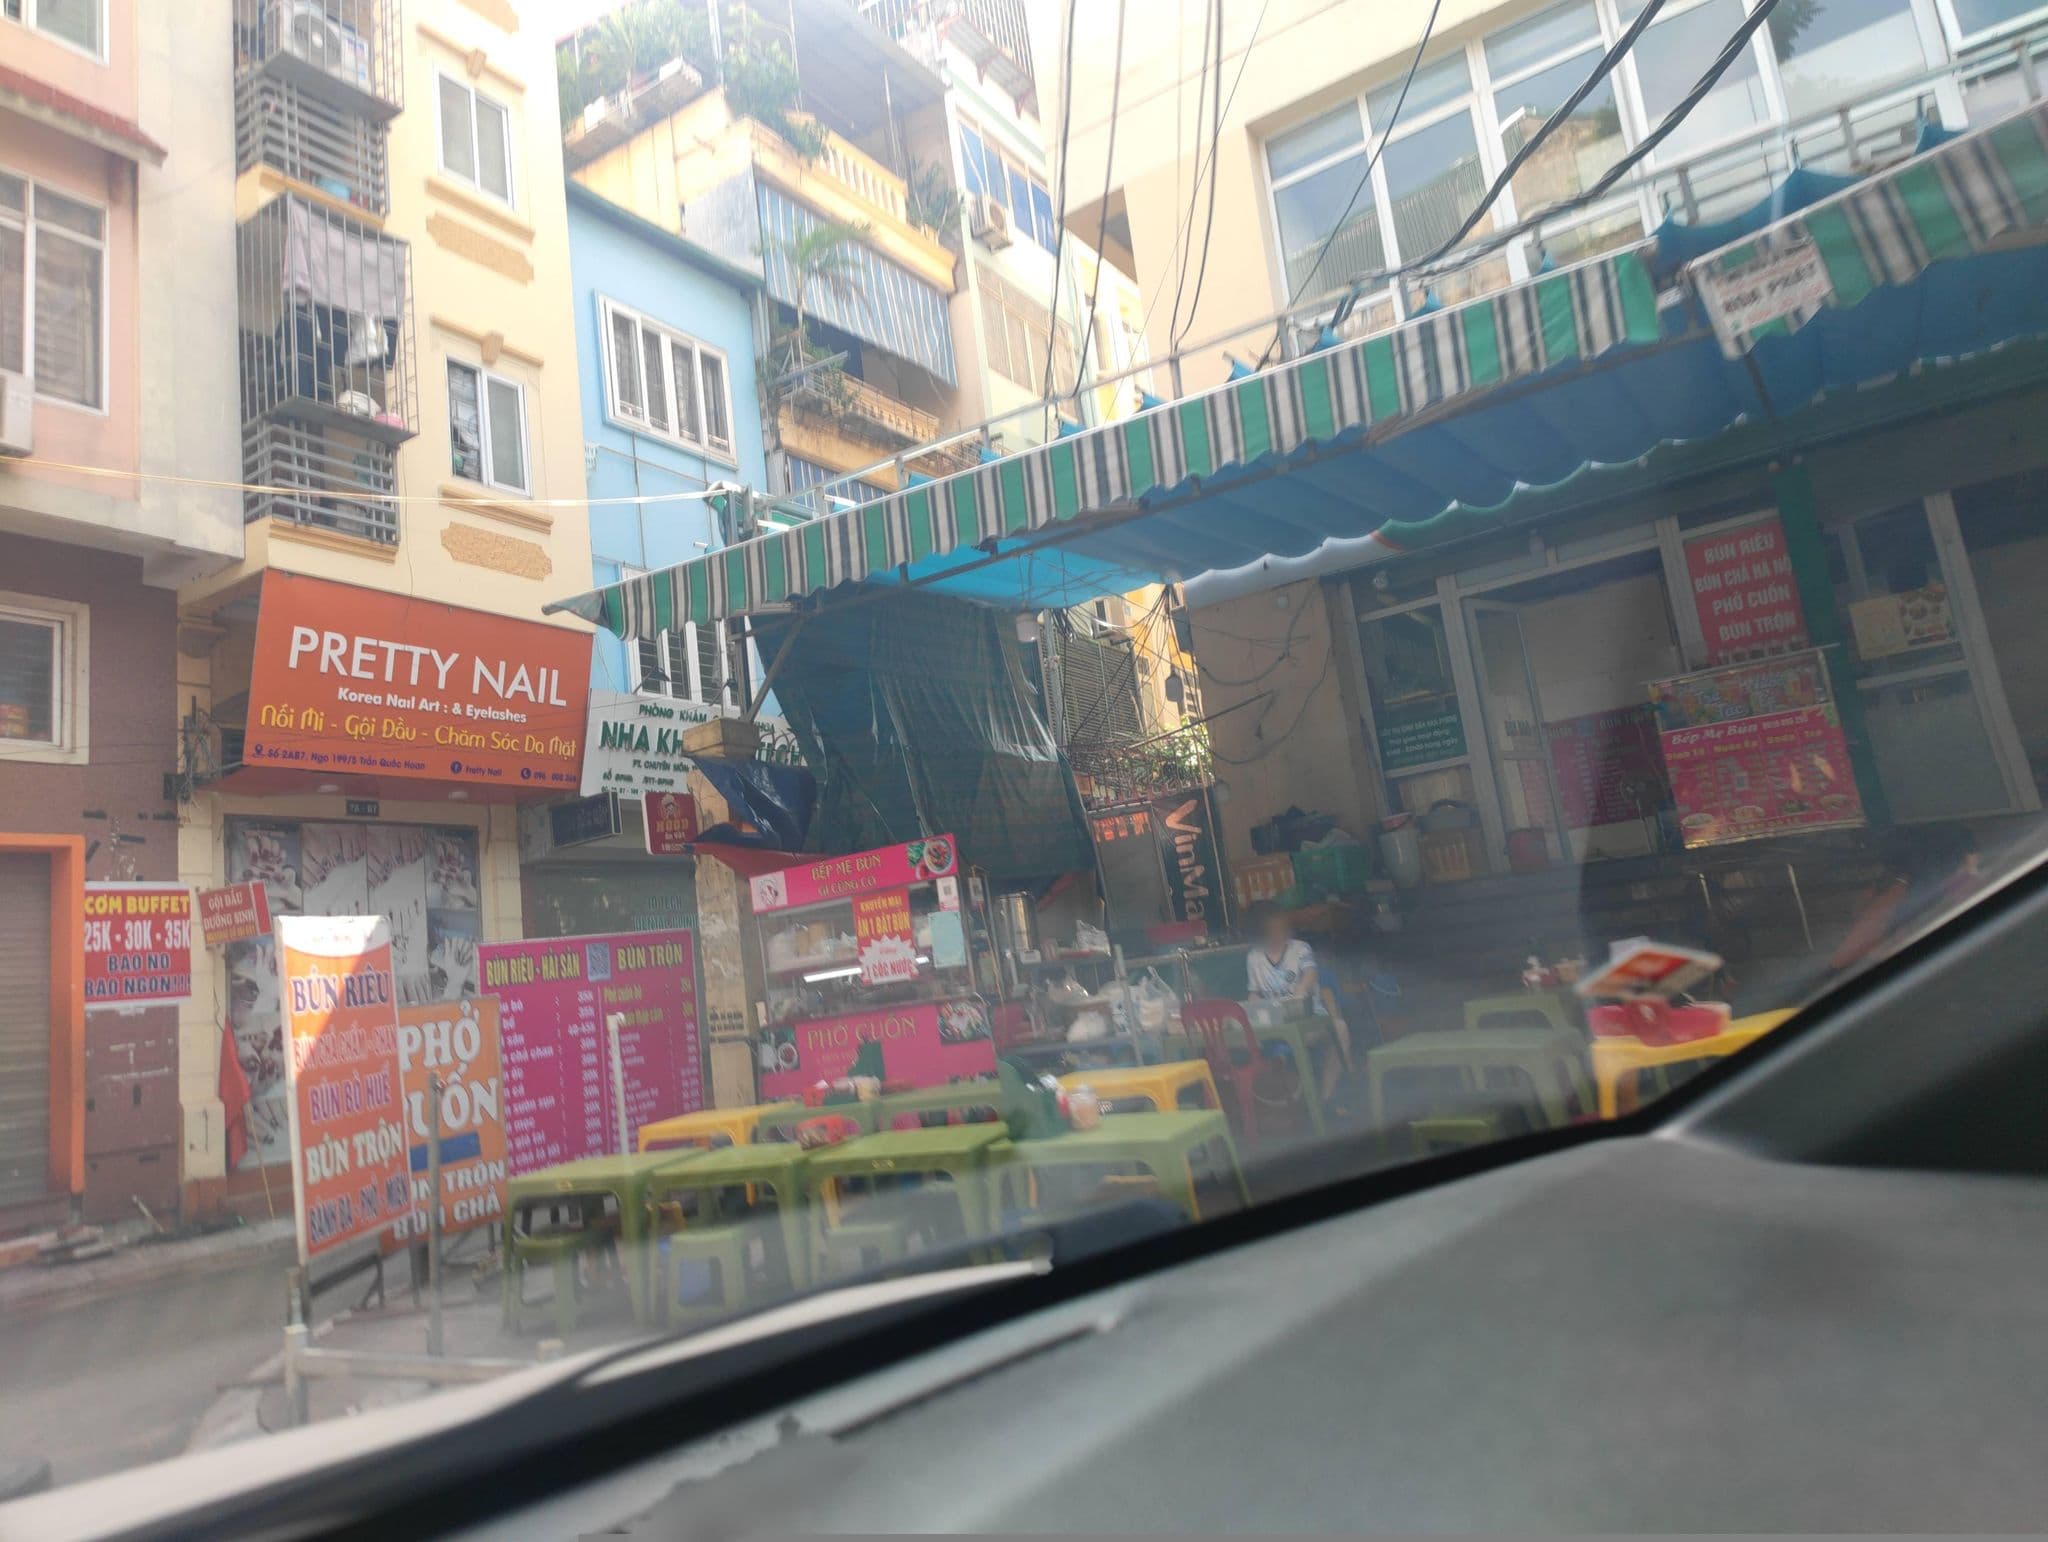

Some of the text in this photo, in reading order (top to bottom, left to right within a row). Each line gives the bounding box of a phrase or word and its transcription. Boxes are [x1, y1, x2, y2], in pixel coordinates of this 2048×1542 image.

[288, 625, 567, 706] PRETTY NAIL
[338, 687, 382, 705] Korea
[386, 693, 415, 709] Nail
[418, 698, 440, 713] Art
[452, 702, 462, 715] &
[466, 704, 527, 723] Eyelashes
[679, 706, 707, 724] KHÁM
[260, 703, 295, 729] Nối
[300, 706, 325, 732] Mi
[345, 713, 377, 741] Gội
[490, 730, 520, 752] Sóc
[524, 734, 545, 754] Da
[549, 735, 577, 760] Mặt
[600, 721, 650, 752] NHA
[84, 893, 190, 915] CƠM BUFFET
[84, 920, 112, 952] 25K
[124, 920, 153, 950] 30K
[164, 919, 190, 950] 35K
[617, 945, 646, 970] BÚN
[648, 940, 683, 969] TRỘN
[290, 962, 391, 1016] BÚN RIÊU
[399, 1000, 482, 1075] PHỞ
[807, 1012, 917, 1051] PHỞ CUỐN
[309, 1078, 341, 1125] BÚN
[365, 1061, 393, 1111] HUẾ
[305, 1116, 404, 1185] BÚN TRỘN
[444, 1158, 505, 1194] TRỘN
[454, 1184, 502, 1224] CHẢ
